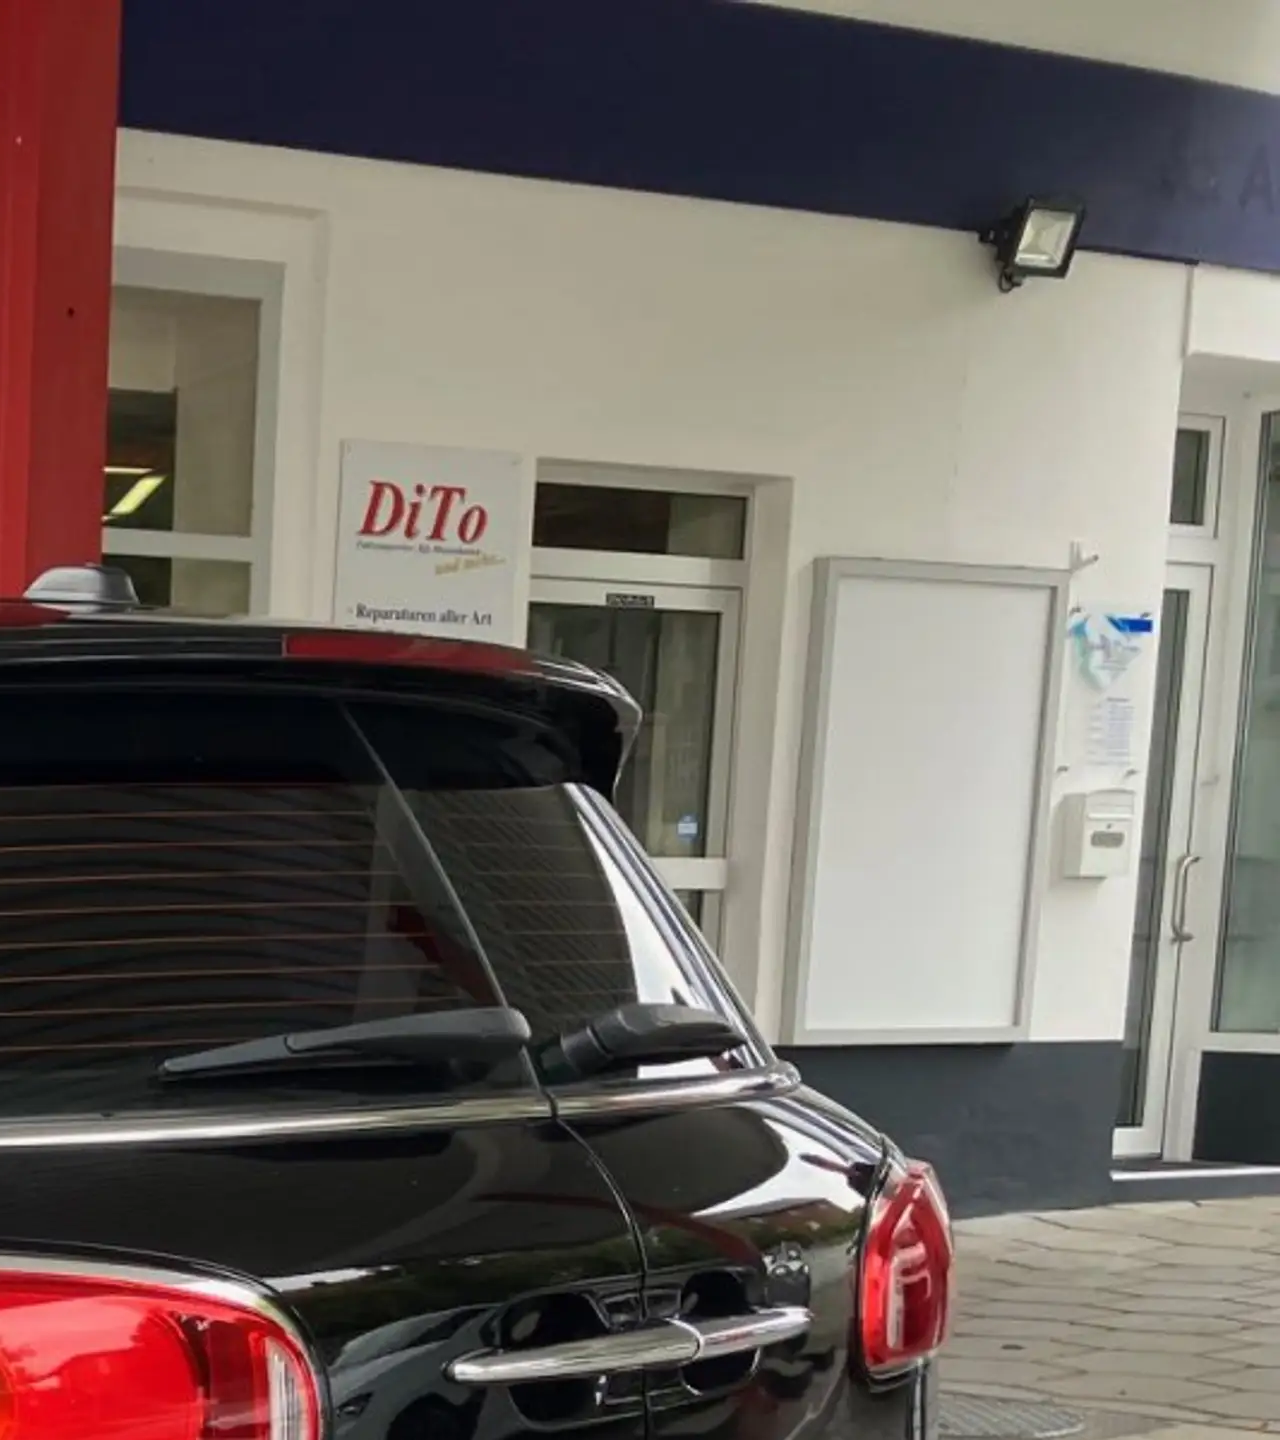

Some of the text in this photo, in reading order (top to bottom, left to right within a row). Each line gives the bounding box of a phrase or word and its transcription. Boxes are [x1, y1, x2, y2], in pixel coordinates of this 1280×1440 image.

[357, 480, 488, 544] DiTo
[356, 603, 492, 627] Reparaturen aller Art
